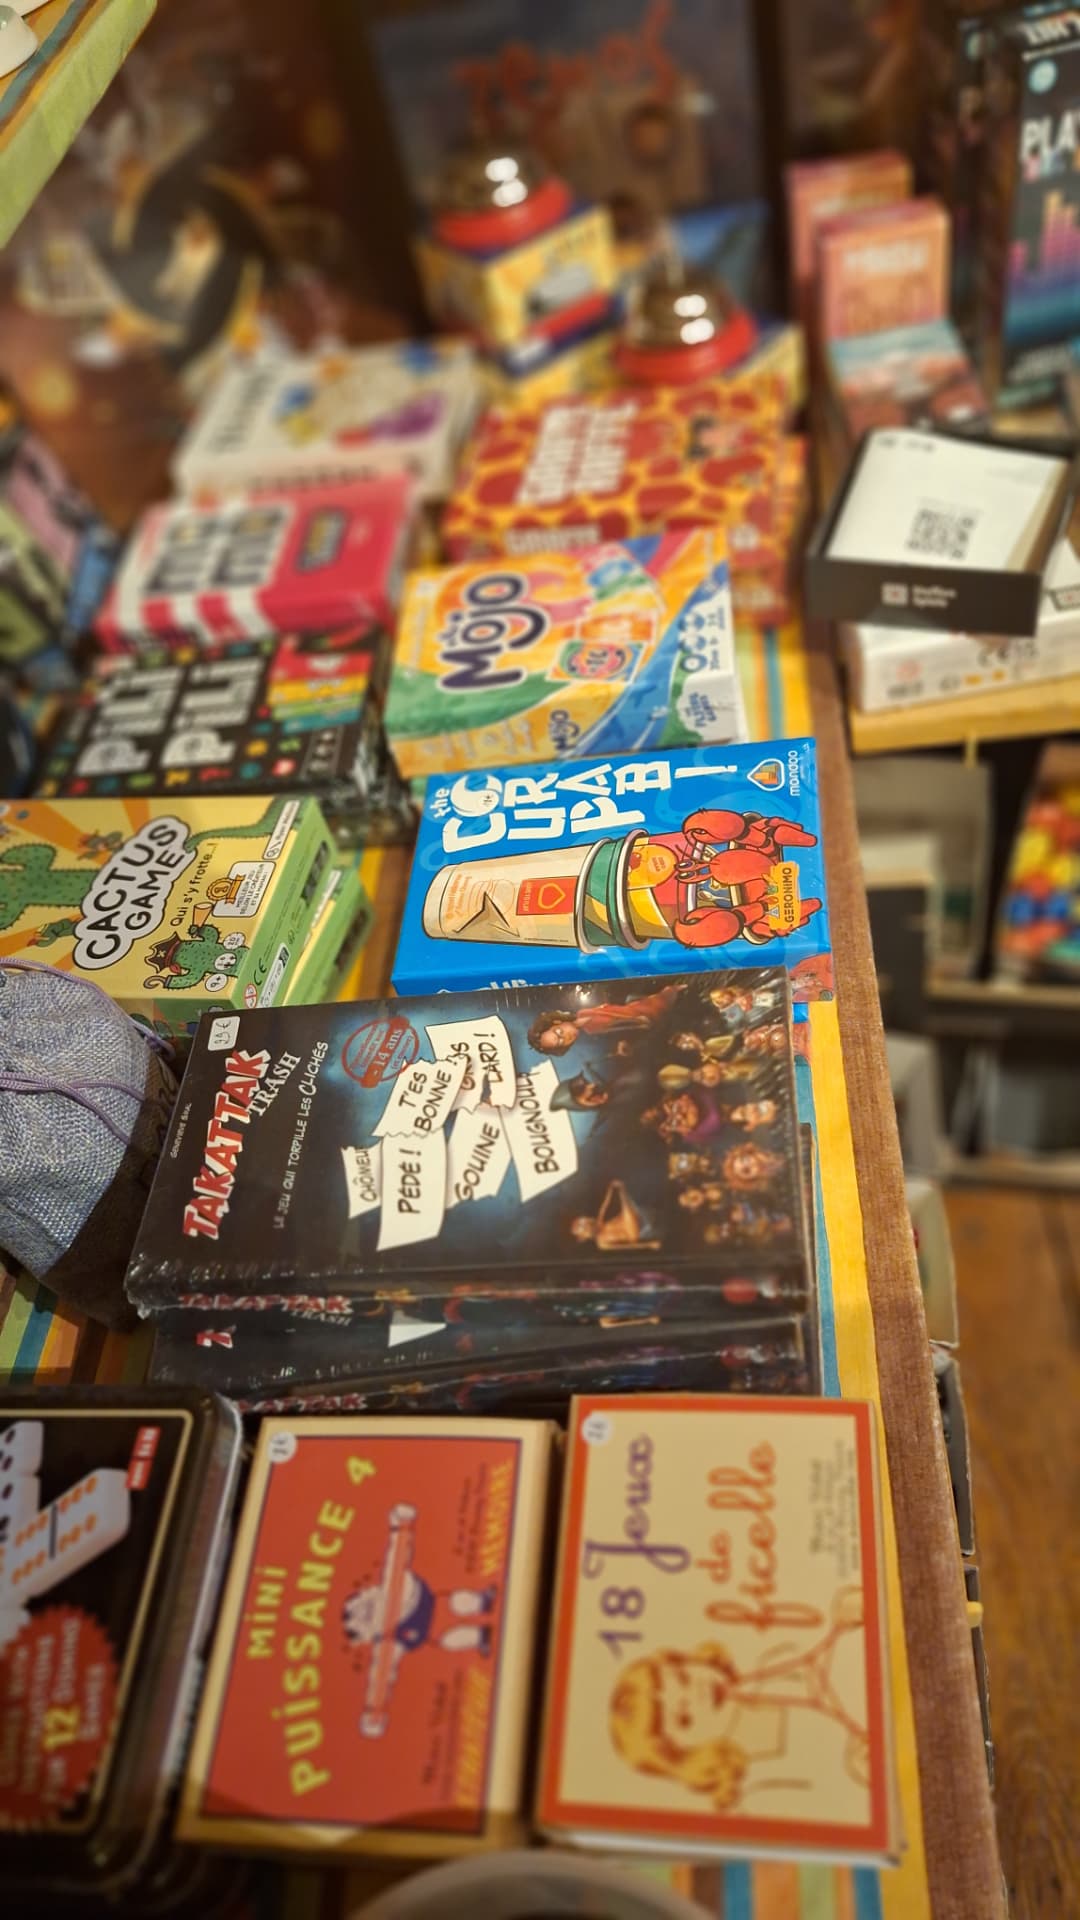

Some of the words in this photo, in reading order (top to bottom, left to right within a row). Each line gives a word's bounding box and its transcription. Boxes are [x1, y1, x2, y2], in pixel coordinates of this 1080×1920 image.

[435, 787, 451, 818] the
[443, 793, 645, 853] CUP
[86, 824, 178, 960] CACTUS
[126, 851, 185, 930] GAME
[171, 897, 186, 927] Qui
[184, 884, 195, 907] s'y
[300, 1041, 329, 1096] CLICHÉS
[374, 1050, 388, 1068] 14
[385, 1030, 403, 1051] ans
[248, 1051, 300, 1117] TRASH
[301, 1097, 312, 1118] LES
[399, 1072, 428, 1107] T'ES
[414, 1069, 452, 1132] BONNE
[182, 1049, 272, 1240] TAKATTAK
[289, 1118, 306, 1167] TORPILLE
[399, 1149, 421, 1157] !
[455, 1122, 500, 1201] GOUINE
[280, 1193, 290, 1216] JEU
[285, 1170, 296, 1193] QUI
[399, 1158, 421, 1214] PÉDÉ
[273, 1216, 284, 1229] LE
[347, 1454, 377, 1487] 4
[696, 1529, 733, 1584] de
[704, 1439, 825, 1631] ficelle
[599, 1586, 645, 1662] 18
